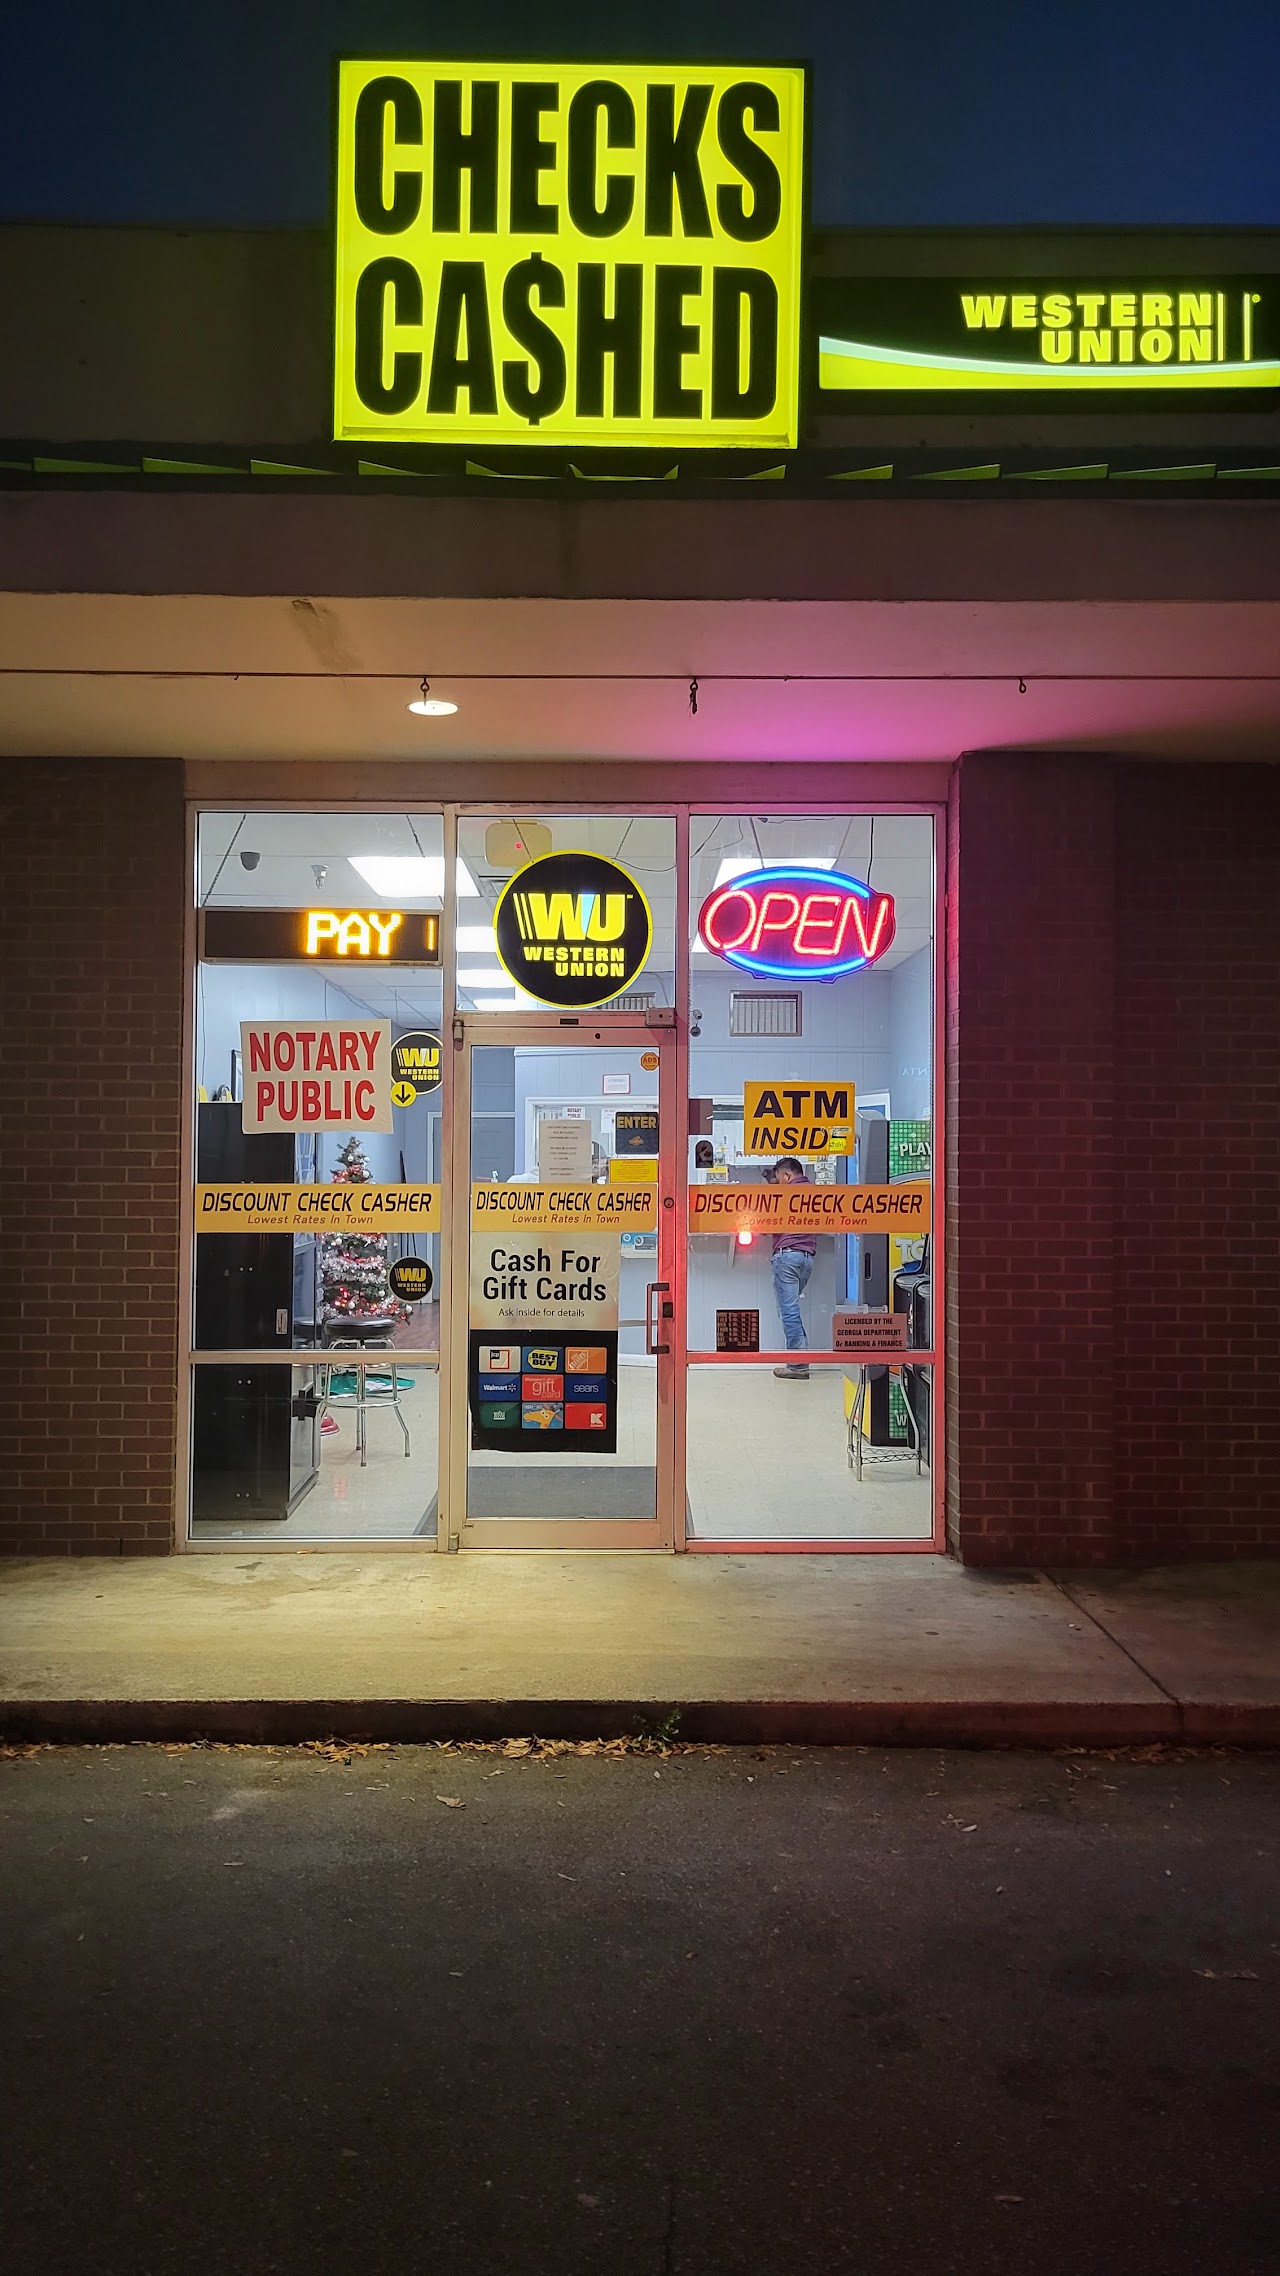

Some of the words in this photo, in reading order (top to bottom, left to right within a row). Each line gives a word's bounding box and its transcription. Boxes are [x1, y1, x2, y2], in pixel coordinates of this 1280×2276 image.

[355, 75, 781, 243] CHECKS
[961, 294, 1212, 329] WESTERN
[355, 252, 778, 426] CA$HED
[1041, 328, 1212, 363] UNION
[526, 892, 626, 942] WU
[704, 889, 889, 958] OPEN
[306, 911, 402, 956] PAY
[523, 946, 625, 962] WESTERN
[555, 962, 625, 977] UNION
[249, 1030, 381, 1072] NOTARY
[401, 1048, 439, 1067] WU
[256, 1079, 375, 1122] PUBLIC
[753, 1090, 848, 1118] ATM
[616, 1116, 657, 1129] ENTER
[202, 1192, 292, 1212] DISCOUNT
[297, 1192, 355, 1212] CHECK
[361, 1193, 432, 1213] CASHER
[476, 1191, 544, 1211] DISCOUNT
[549, 1192, 592, 1211] CHECK
[597, 1192, 652, 1212] CASHER
[694, 1193, 783, 1213] DISCOUNT
[789, 1193, 845, 1213] CHECK
[851, 1194, 923, 1214] CASHER
[247, 1214, 289, 1224] Lowest
[293, 1214, 326, 1224] Rates
[330, 1215, 340, 1224] In
[344, 1214, 373, 1224] Town
[512, 1213, 547, 1223] Lowest
[551, 1214, 579, 1223] Rates
[583, 1214, 591, 1223] In
[596, 1214, 620, 1224] Town
[743, 1215, 783, 1226] Lowest
[787, 1215, 821, 1226] Rates
[824, 1215, 835, 1225] In
[840, 1215, 867, 1226] Town
[490, 1248, 551, 1272] Cash
[561, 1250, 601, 1273] For
[398, 1268, 427, 1282] WU
[483, 1275, 528, 1300] Gift
[536, 1276, 607, 1302] Cards
[499, 1308, 514, 1316] Ask
[516, 1308, 541, 1317] inside
[543, 1308, 555, 1317] for
[557, 1309, 585, 1317] details
[531, 1352, 557, 1360] BEST
[532, 1359, 555, 1367] BUY
[532, 1378, 555, 1396] gift
[541, 1390, 561, 1398] card
[573, 1384, 599, 1393] sears
